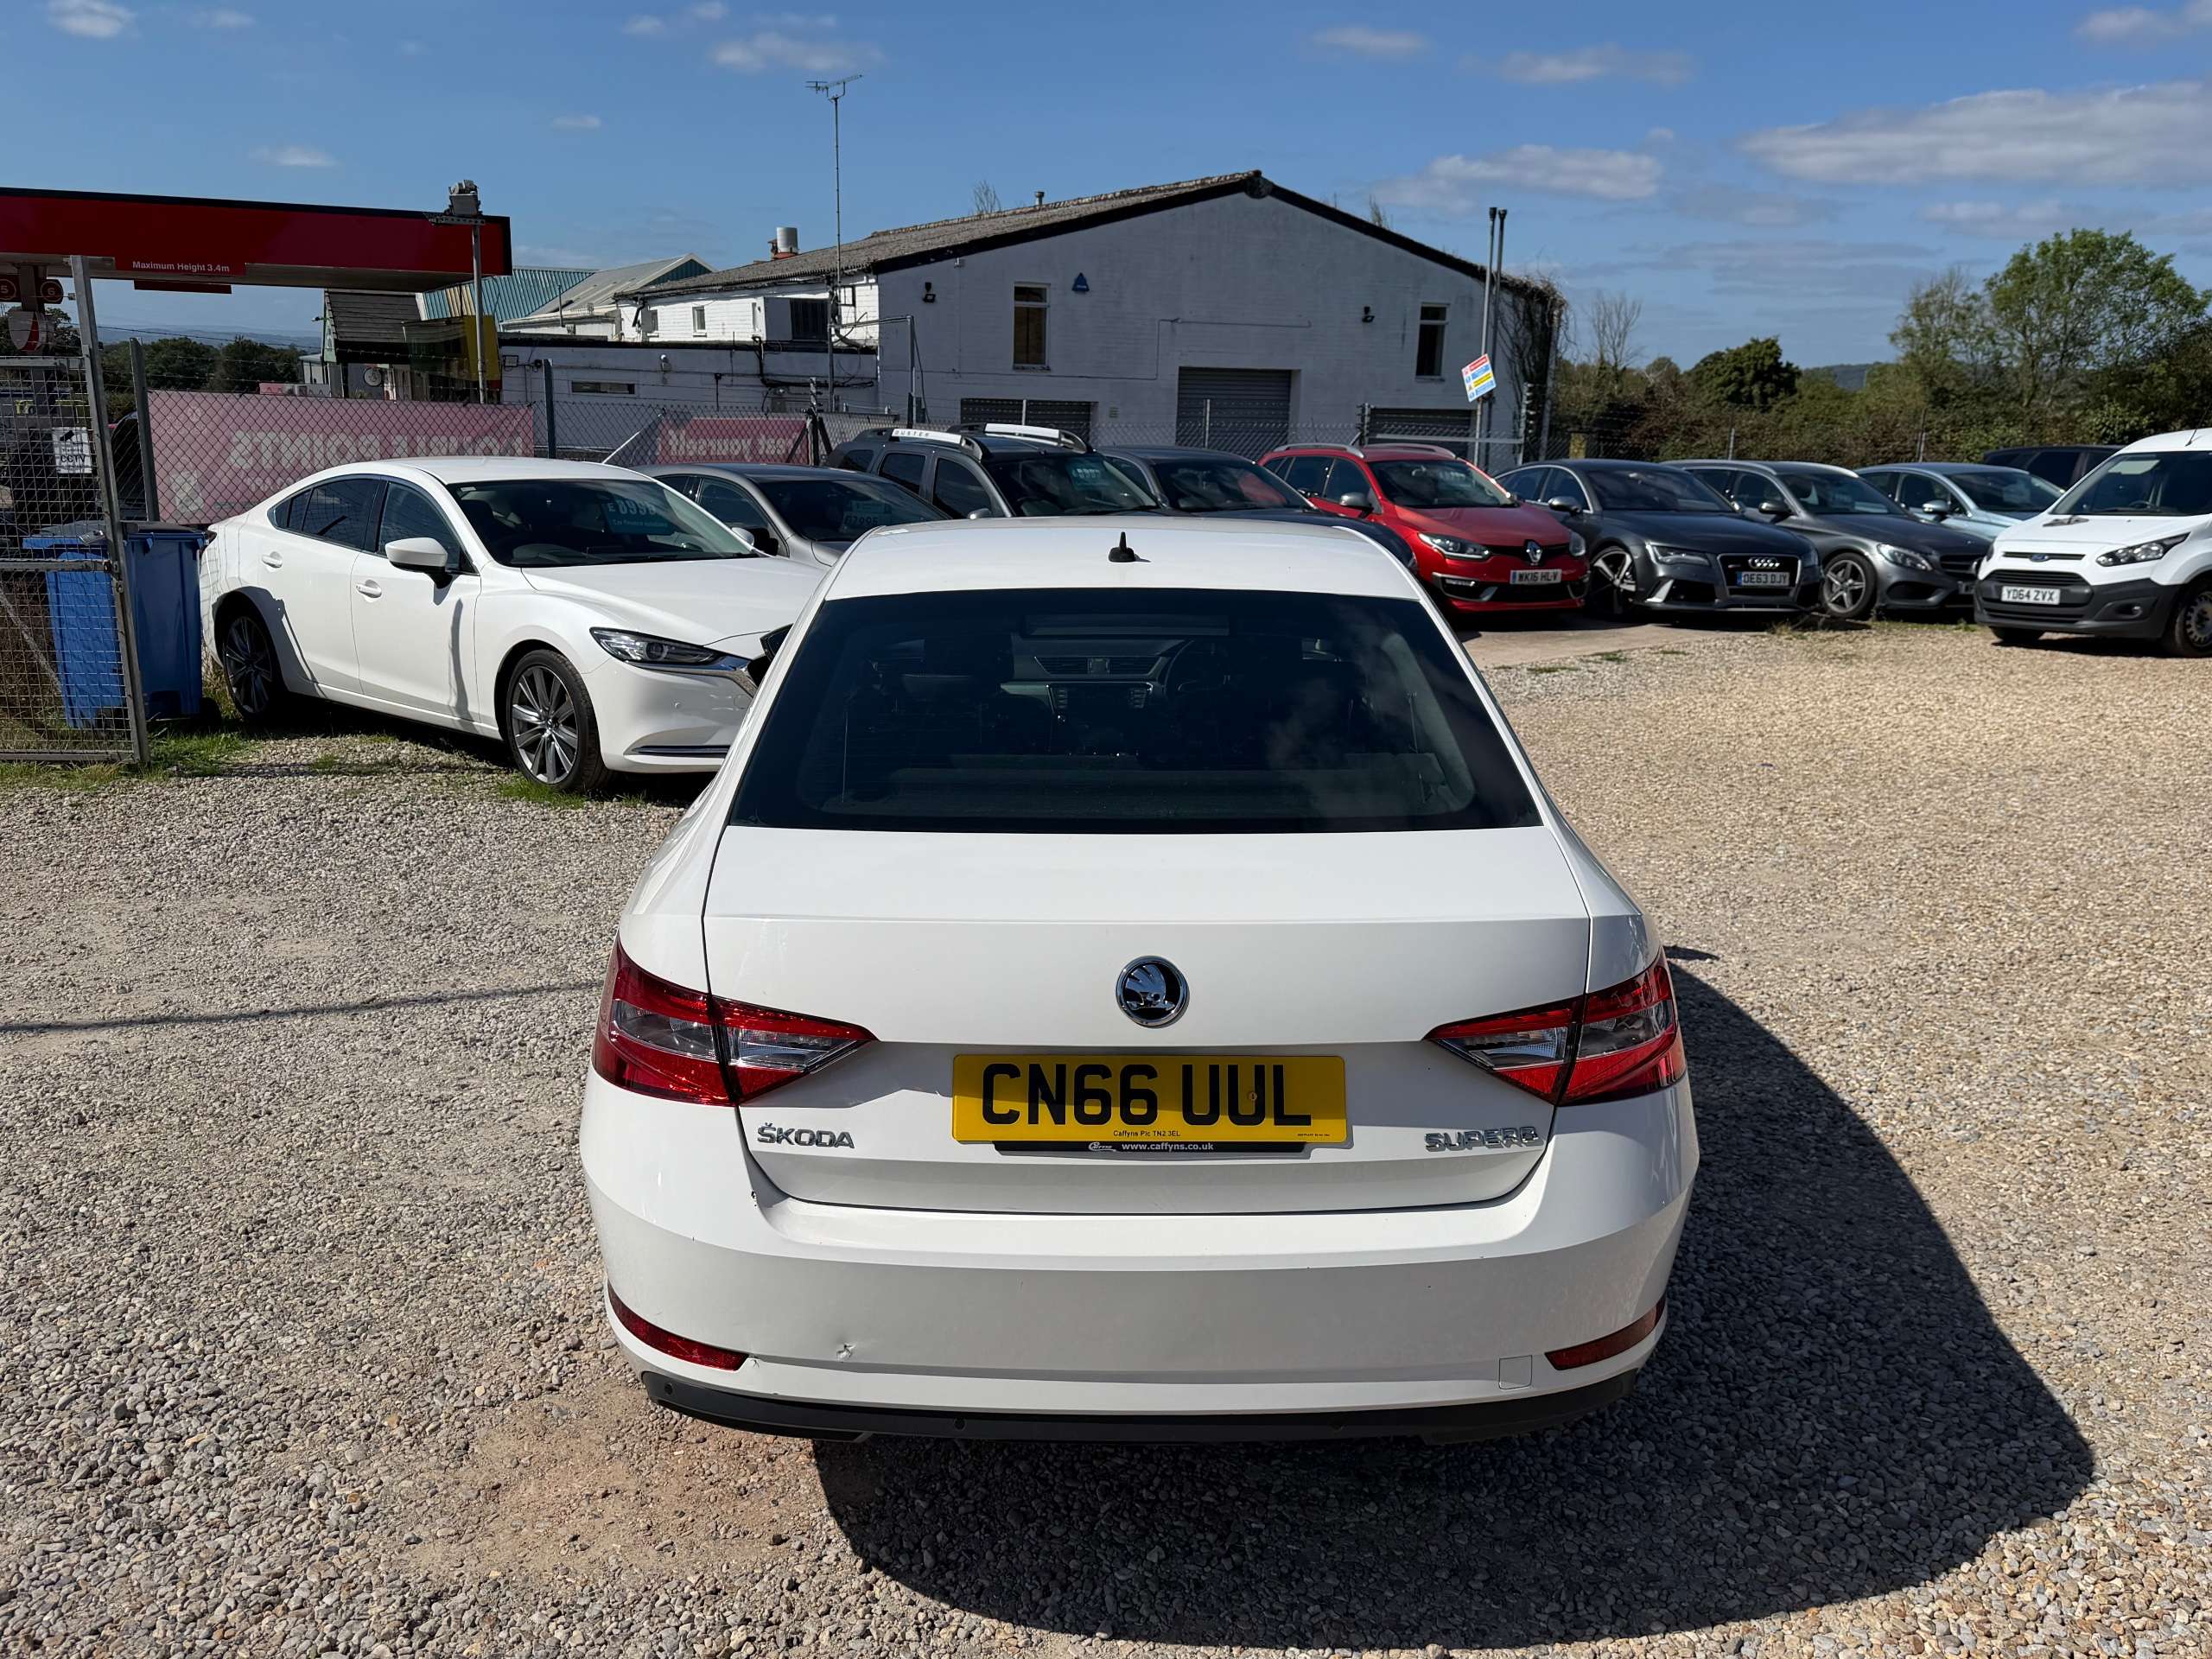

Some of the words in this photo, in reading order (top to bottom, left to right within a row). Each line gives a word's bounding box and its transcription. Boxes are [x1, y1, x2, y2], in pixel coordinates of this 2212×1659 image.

[132, 261, 175, 270] Maximum
[177, 263, 206, 272] Height
[207, 264, 230, 272] 3.4m
[60, 454, 86, 463] CCTV
[2005, 589, 2031, 600] YD64
[982, 1063, 1159, 1126] CN66
[1181, 1064, 1313, 1126] UUL
[757, 1122, 855, 1149] ŠKODA
[1113, 1129, 1138, 1138] Caffyns
[1425, 1127, 1543, 1152] SUPERB
[1122, 1141, 1214, 1152] www.caffyns.co.uk
